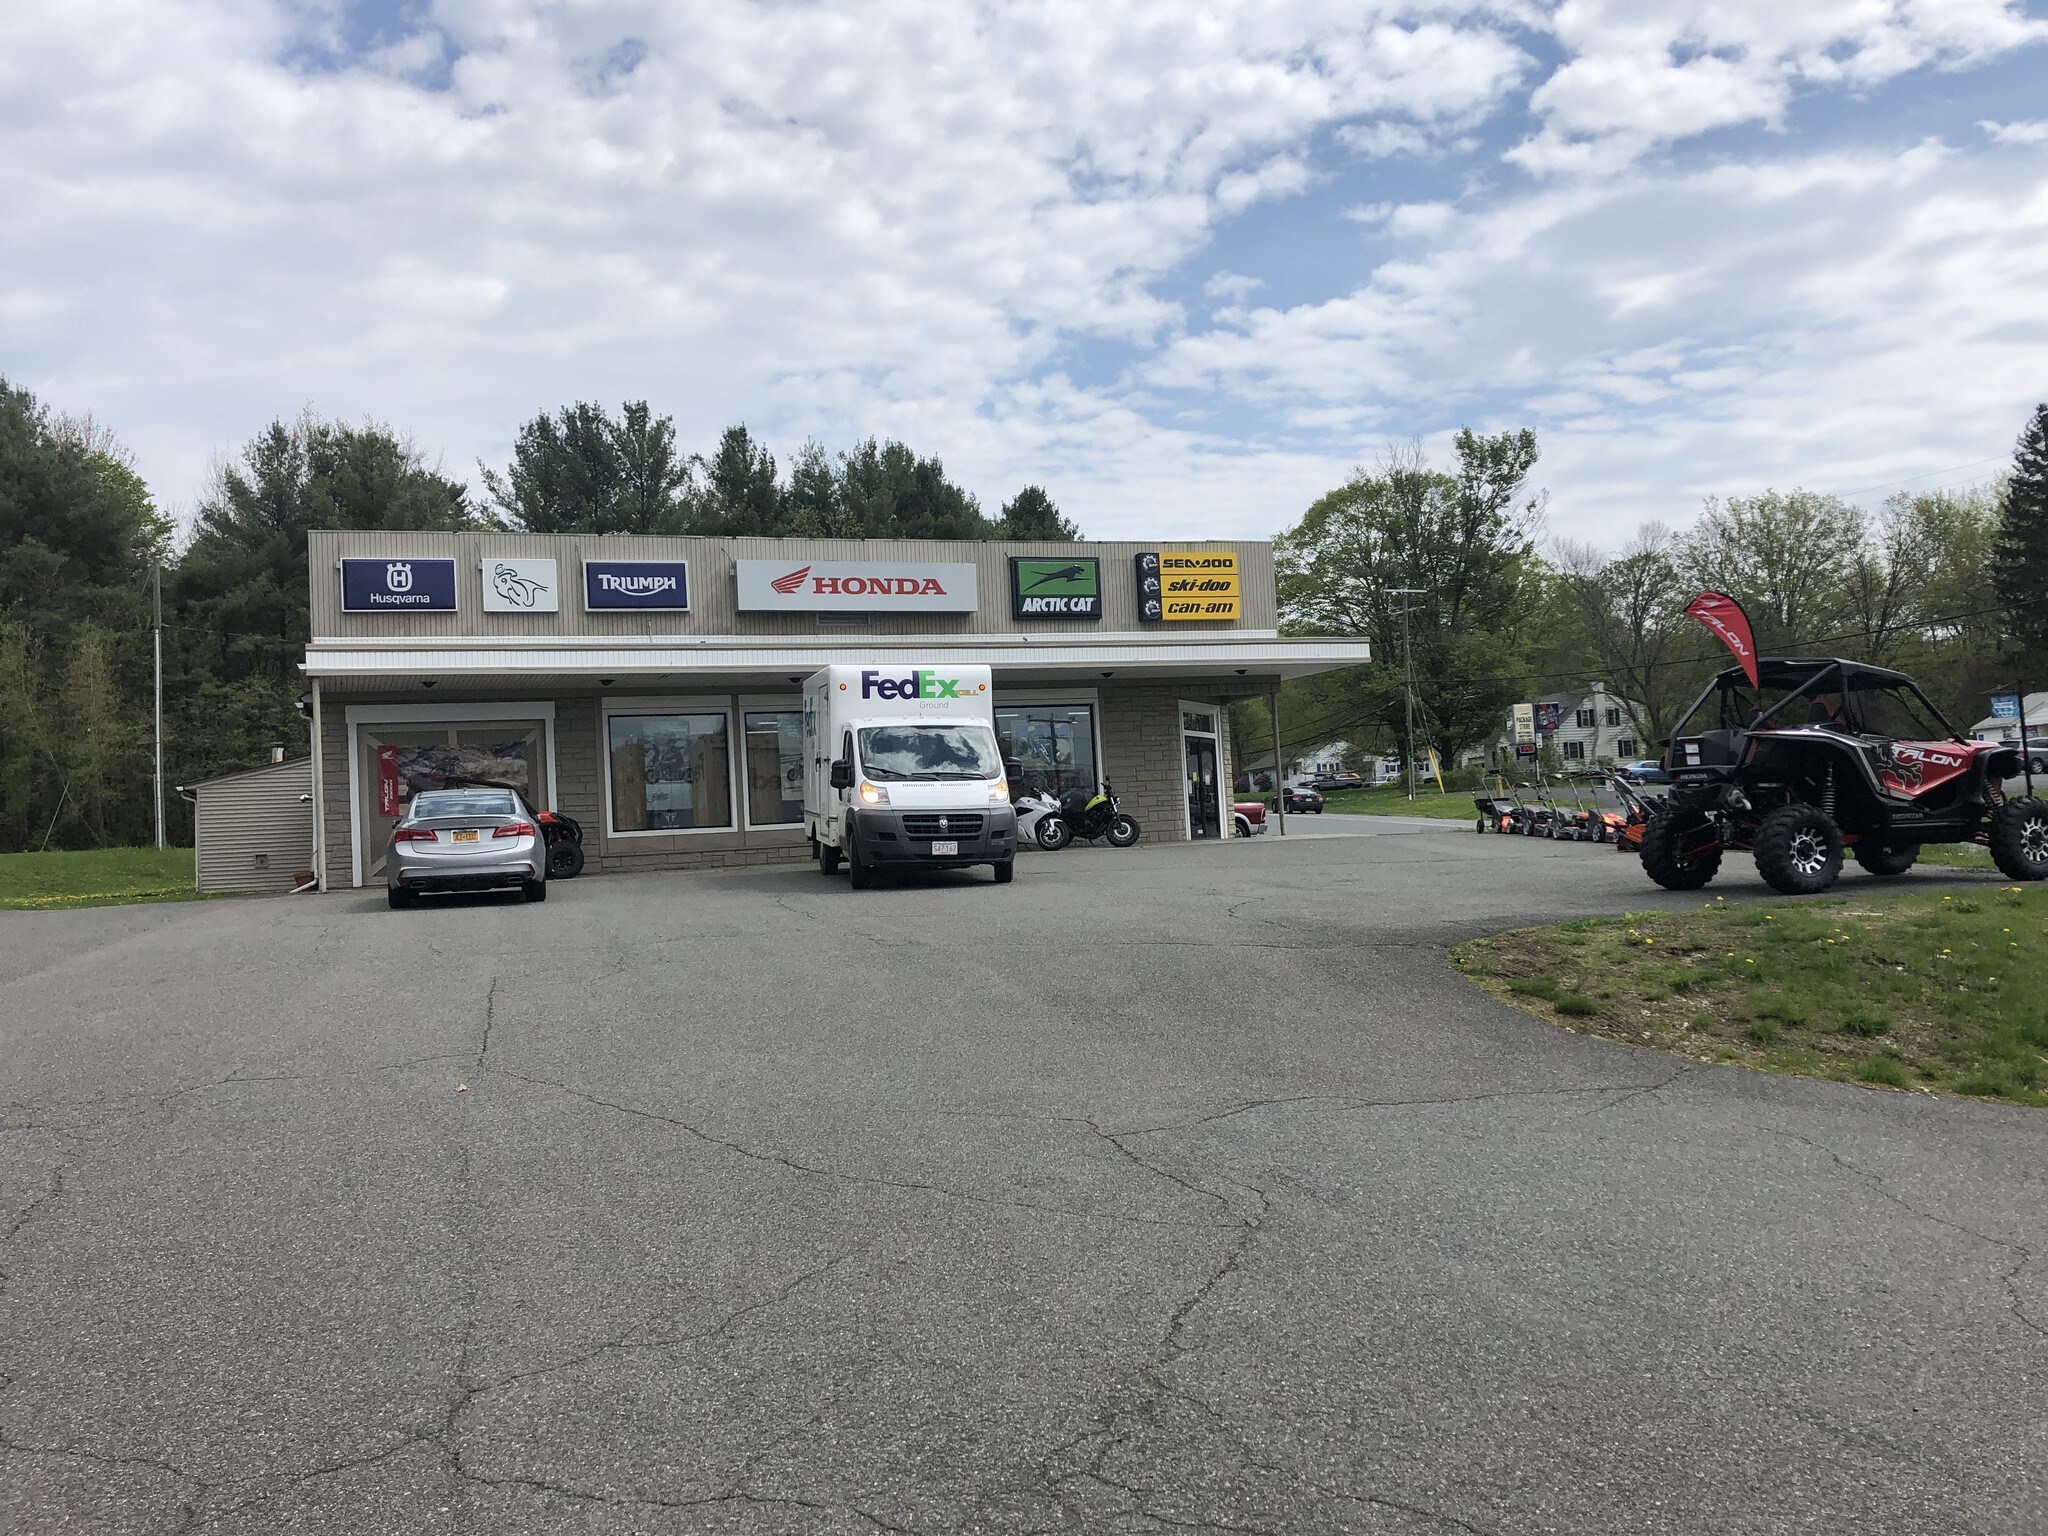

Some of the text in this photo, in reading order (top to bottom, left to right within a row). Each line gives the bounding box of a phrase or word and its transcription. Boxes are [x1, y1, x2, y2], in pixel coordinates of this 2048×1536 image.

[597, 574, 677, 596] TRIUMPH
[812, 577, 947, 595] HONDA
[1167, 579, 1232, 592] ski-doo
[370, 593, 430, 605] Husqvarna
[1021, 597, 1094, 612] ARCTIC CAT
[1167, 602, 1234, 614] can-am
[1695, 609, 1750, 656] TALON
[861, 670, 960, 700] FedEx
[919, 701, 949, 709] Ground
[1890, 743, 1963, 767] TALON
[1892, 812, 1924, 820] HONDA
